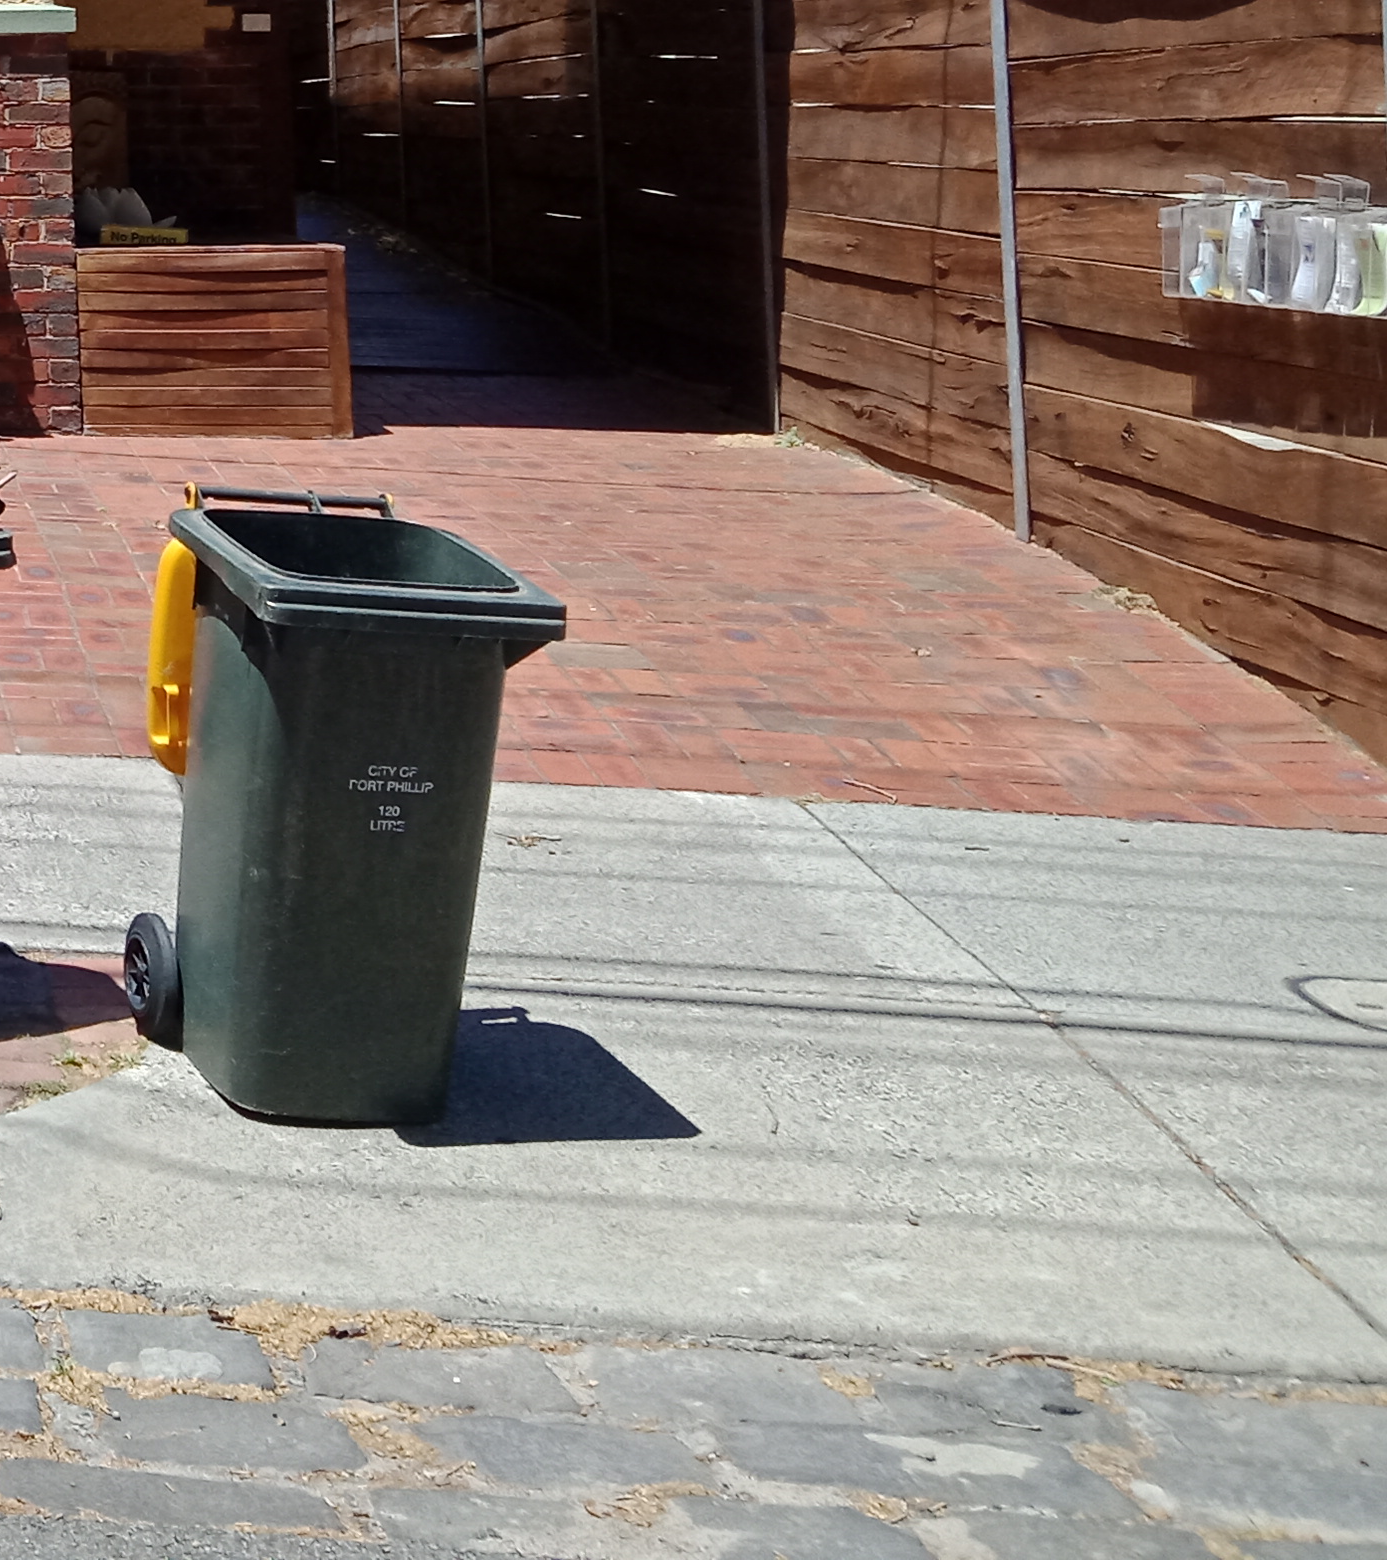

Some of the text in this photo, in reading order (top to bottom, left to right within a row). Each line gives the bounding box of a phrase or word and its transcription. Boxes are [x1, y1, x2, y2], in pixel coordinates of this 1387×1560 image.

[110, 231, 178, 244] No Parking
[368, 764, 418, 778] CITY OF
[349, 779, 434, 793] PORT PHILLIP
[378, 805, 401, 817] 120
[370, 820, 406, 832] LITRE
